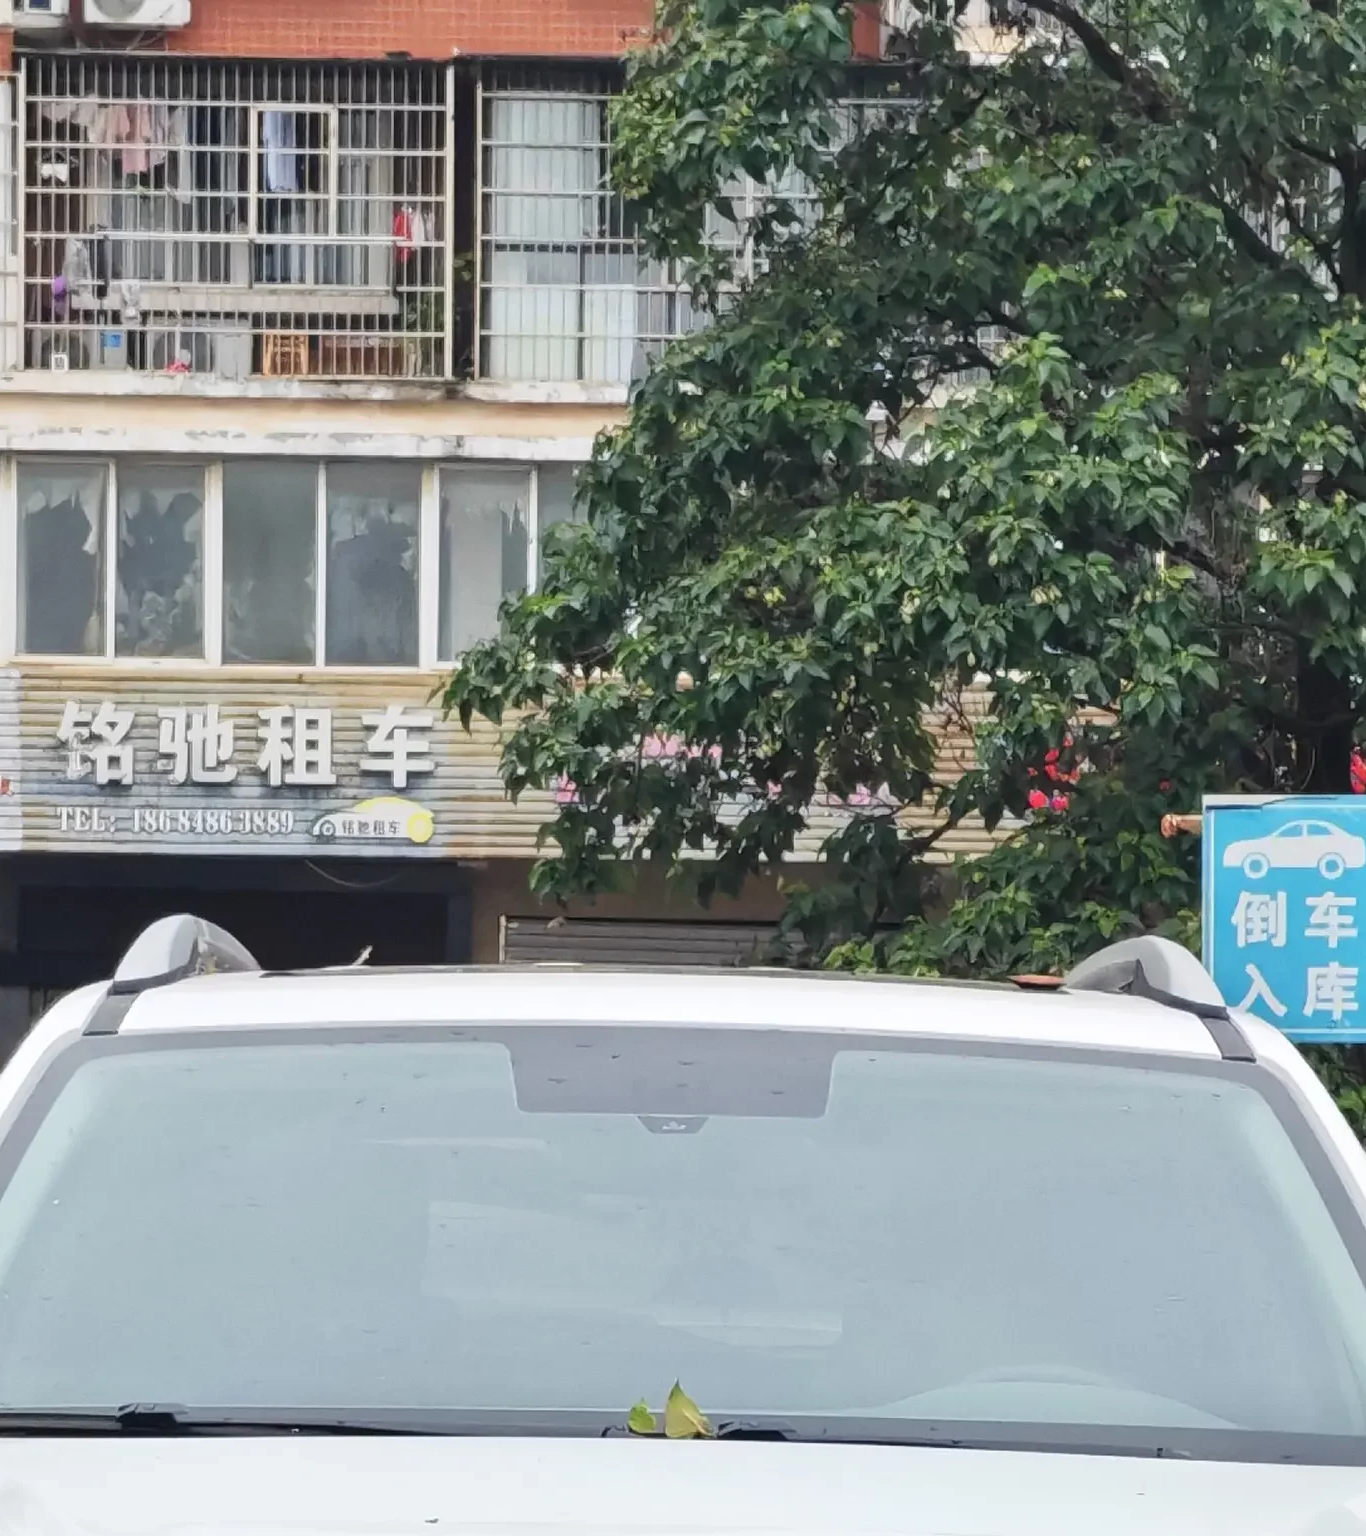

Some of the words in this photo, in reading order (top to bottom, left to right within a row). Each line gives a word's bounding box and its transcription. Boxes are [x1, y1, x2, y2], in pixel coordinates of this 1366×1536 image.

[57, 701, 435, 788] 铭驰租车
[1231, 890, 1359, 948] 倒车
[1235, 961, 1359, 1022] 入库
